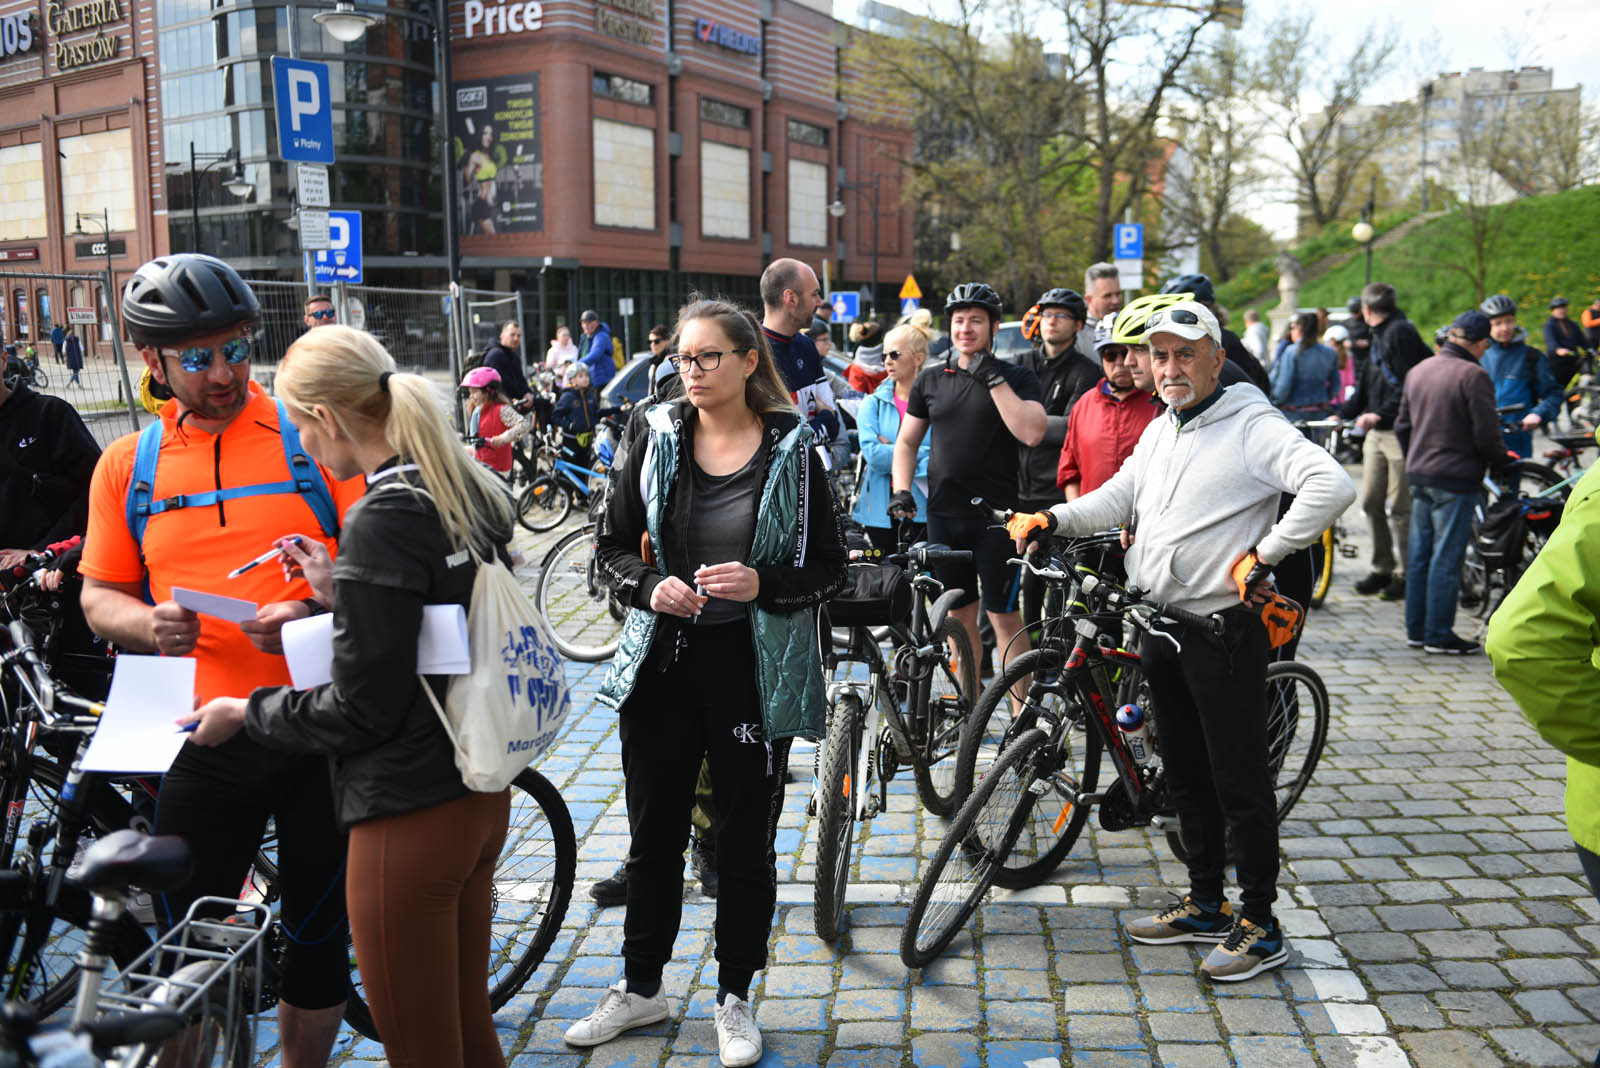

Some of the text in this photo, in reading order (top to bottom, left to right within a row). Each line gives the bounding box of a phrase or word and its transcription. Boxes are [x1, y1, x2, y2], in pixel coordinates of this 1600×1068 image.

[48, 0, 121, 36] GALERIA
[465, 0, 543, 38] Price
[55, 30, 119, 69] PIASTÓW
[287, 68, 321, 132] P
[92, 243, 107, 255] CCC
[1120, 227, 1138, 249] P
